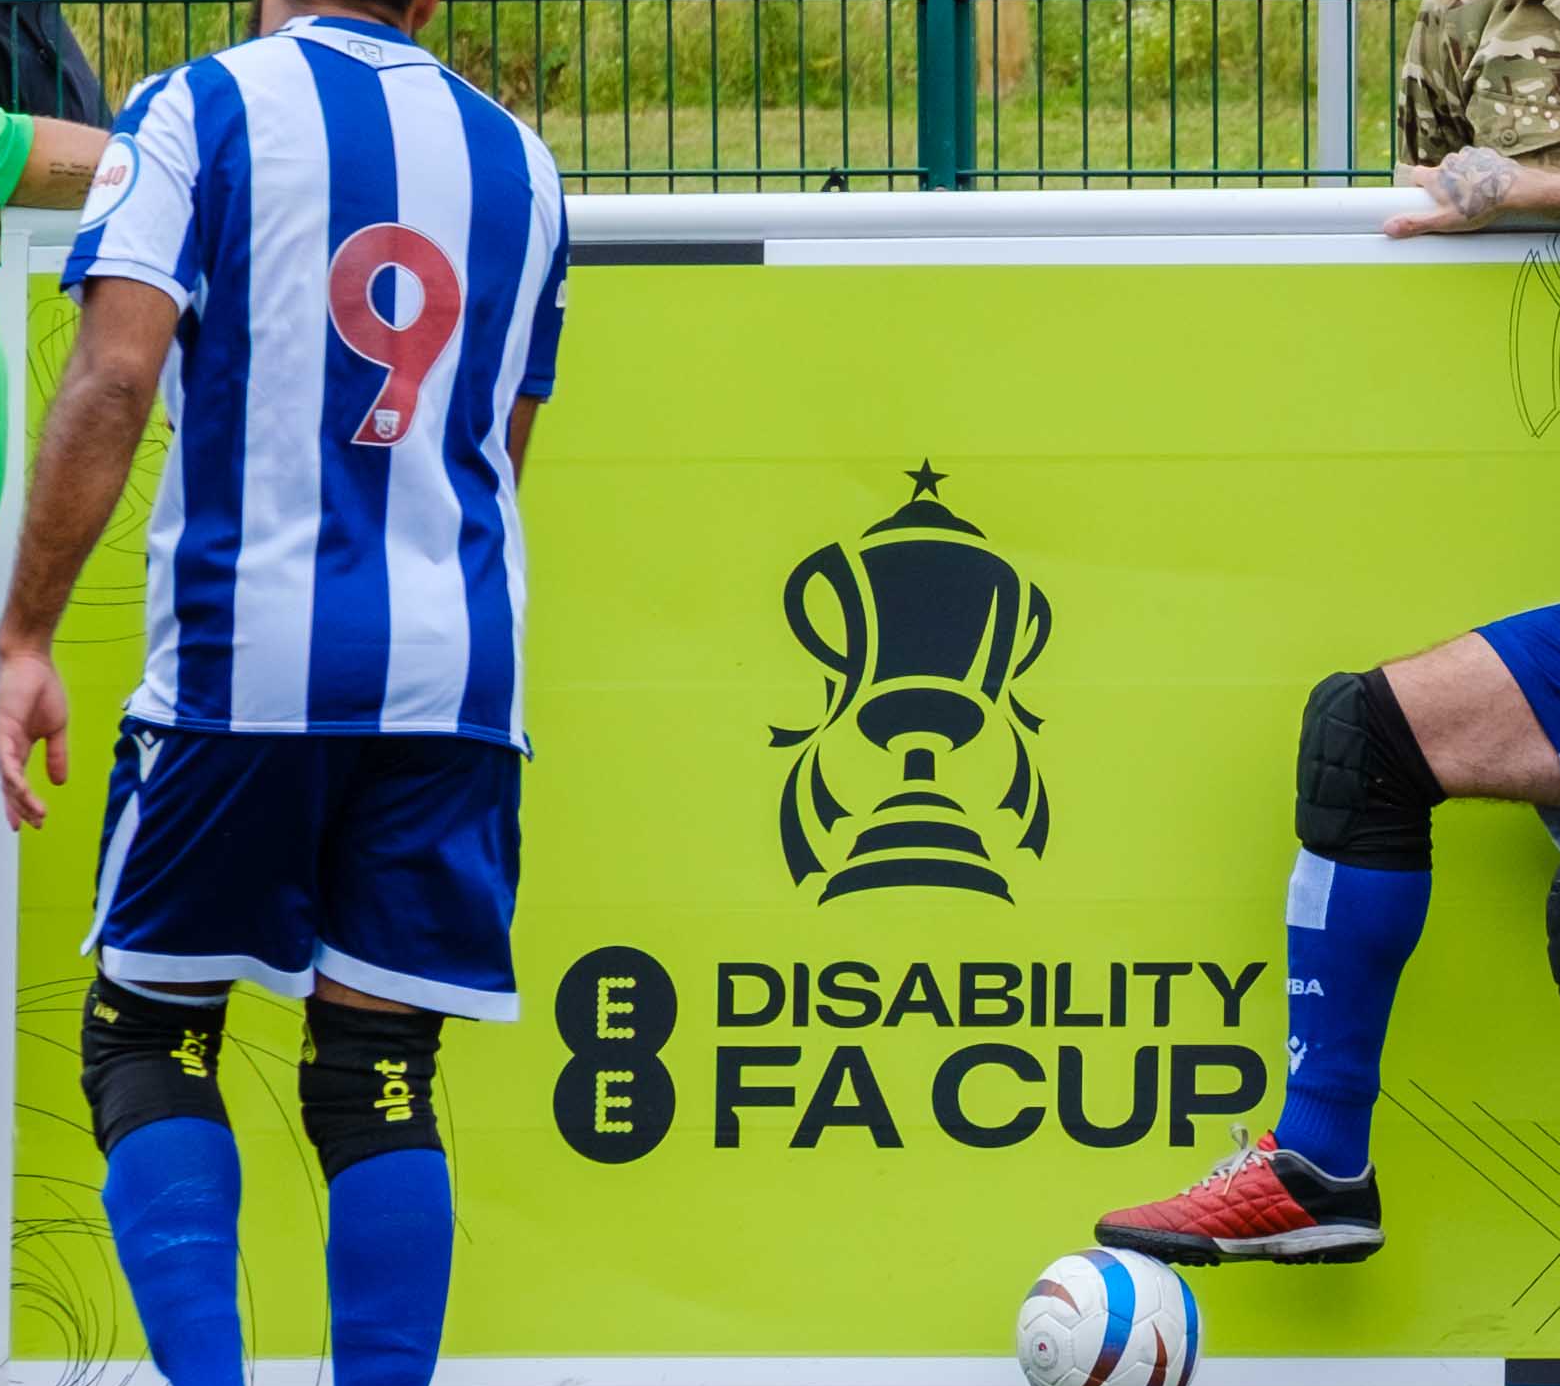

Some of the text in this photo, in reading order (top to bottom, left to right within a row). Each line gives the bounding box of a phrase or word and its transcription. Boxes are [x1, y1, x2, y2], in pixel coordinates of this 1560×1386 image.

[327, 221, 464, 447] 9
[717, 961, 1268, 1029] DISABILITY
[714, 1042, 1268, 1149] FA CUP
